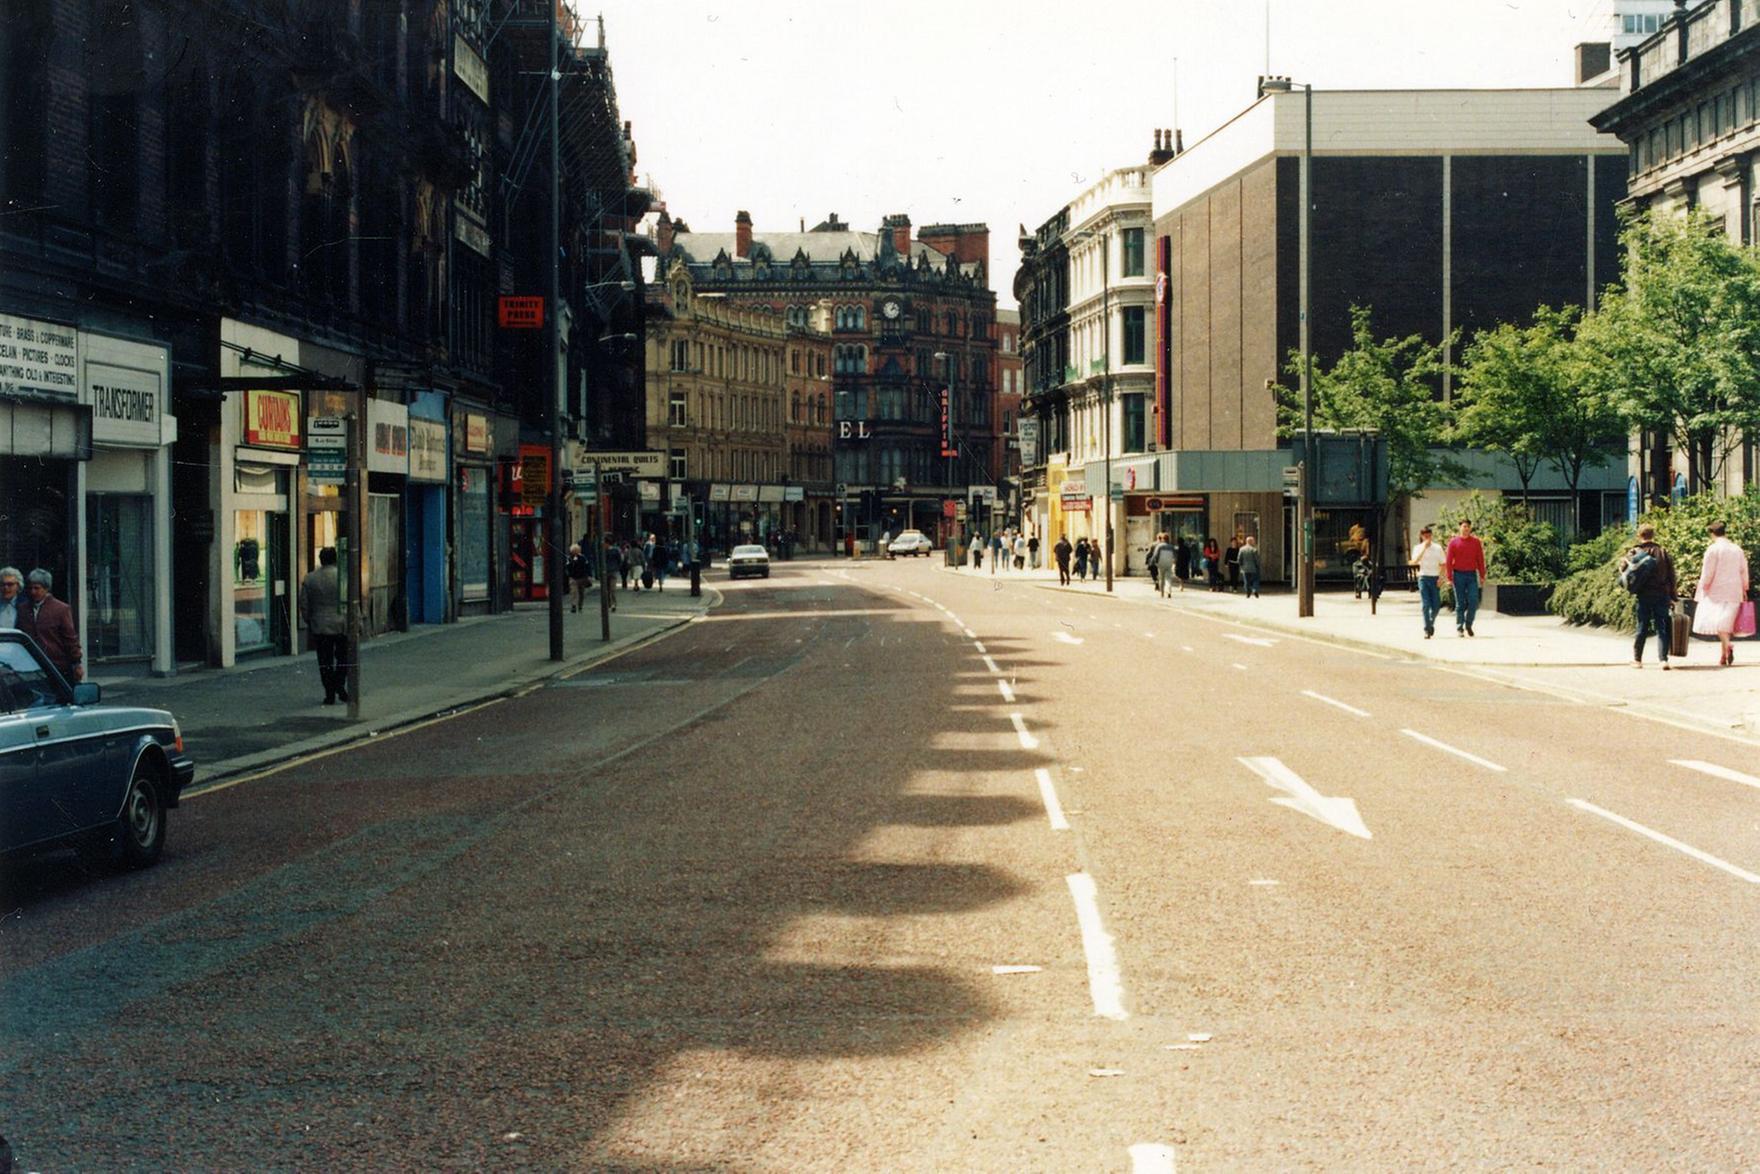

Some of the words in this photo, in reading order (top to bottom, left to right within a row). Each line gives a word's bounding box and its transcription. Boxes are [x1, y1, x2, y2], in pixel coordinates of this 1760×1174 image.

[16, 327, 34, 342] BRASS
[40, 331, 75, 350] COPPERWARE
[22, 347, 49, 365] PICTURES
[54, 353, 75, 368] CLOCKS
[25, 367, 38, 381] OLD
[43, 371, 76, 386] INTERESTING
[92, 384, 154, 423] TRANSFORMER
[257, 394, 291, 432] CURTAINS
[581, 455, 630, 465] CONTINENTAL
[633, 455, 659, 464] QUILTS
